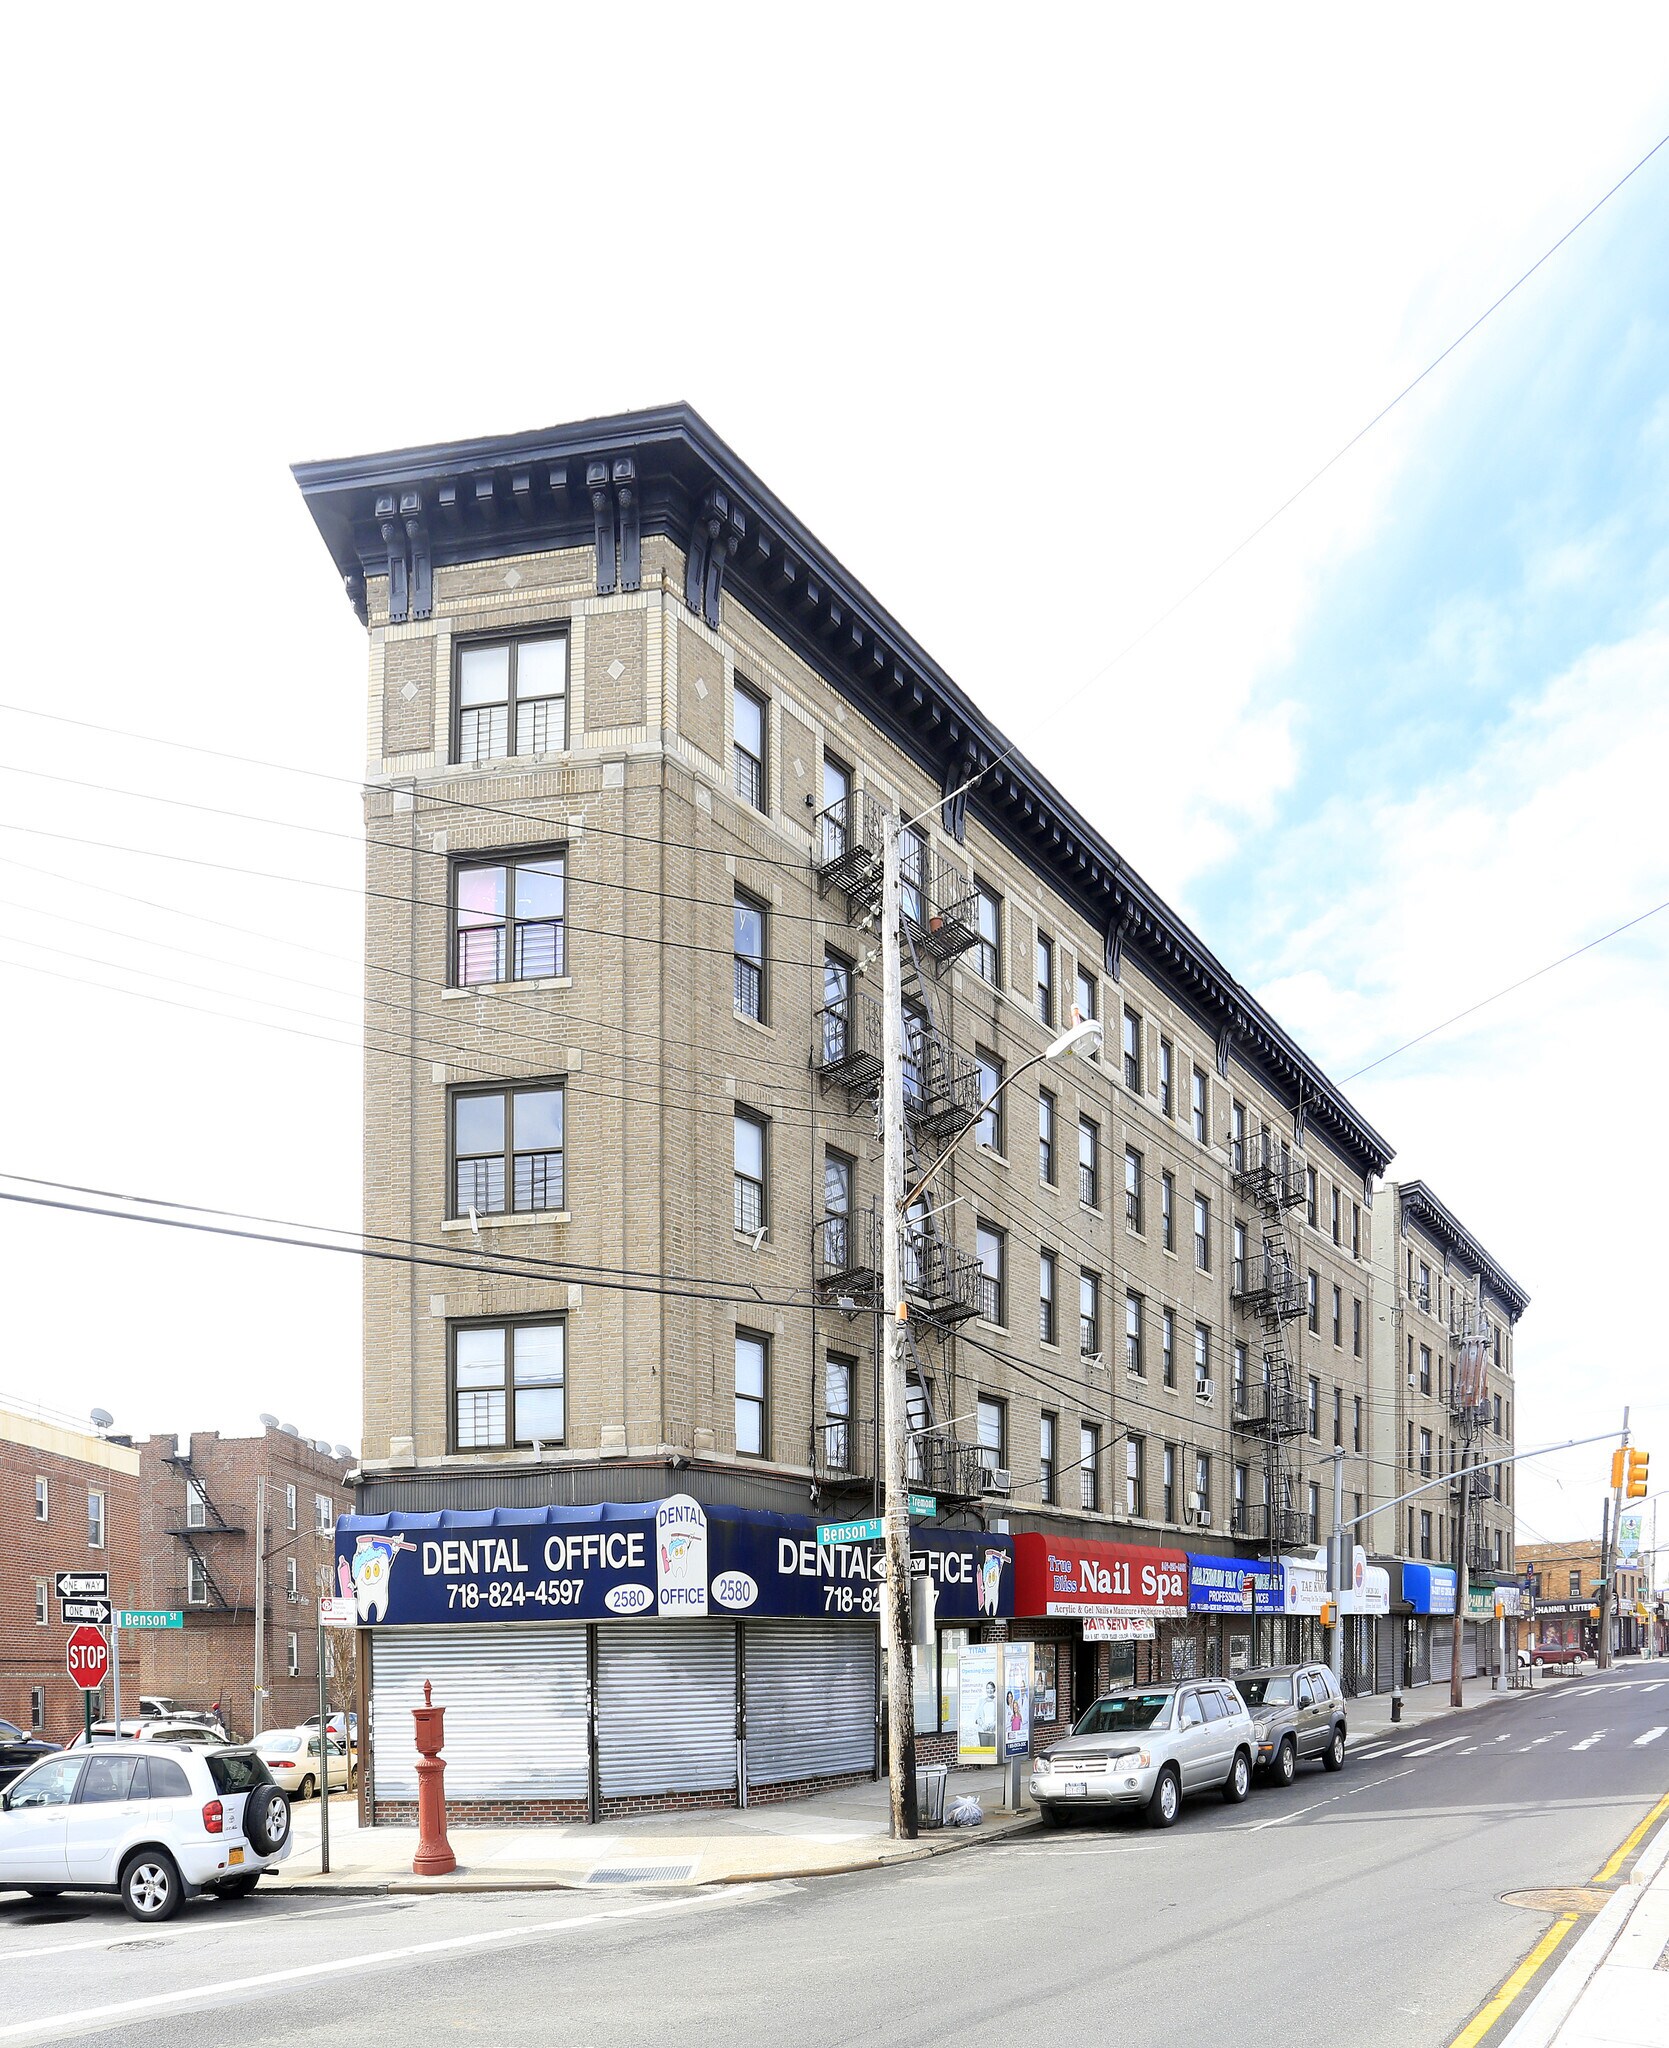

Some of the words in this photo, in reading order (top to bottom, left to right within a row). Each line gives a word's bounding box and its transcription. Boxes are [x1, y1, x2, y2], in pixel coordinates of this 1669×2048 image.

[912, 1496, 934, 1508] Tremont
[659, 1506, 705, 1529] DENTAL
[823, 1525, 866, 1542] Benson
[870, 1521, 877, 1530] St
[422, 1538, 529, 1576] DENTAL
[544, 1533, 646, 1572] OFFICE
[1048, 1555, 1072, 1573] True
[64, 1580, 78, 1590] ONE
[85, 1580, 101, 1590] WAY
[720, 1579, 750, 1602] 2580
[1054, 1575, 1077, 1592] Bliss
[1079, 1560, 1131, 1594] Nail
[1141, 1565, 1184, 1604] Spa
[1301, 1581, 1312, 1592] TAE
[446, 1579, 585, 1609] 718-824-4597
[613, 1583, 645, 1607] 2580
[660, 1588, 705, 1605] OFFICE
[1209, 1590, 1243, 1603] PROFESSIONA
[70, 1606, 83, 1616] ONE
[89, 1607, 104, 1617] WAY
[1054, 1605, 1077, 1615] Acrylic
[1078, 1606, 1082, 1614] &
[1084, 1606, 1094, 1614] Gel
[1095, 1606, 1109, 1614] Nails
[1112, 1606, 1137, 1615] Manicure
[1535, 1604, 1567, 1614] CHANNEL
[125, 1612, 167, 1626] Benson
[170, 1612, 177, 1621] St
[70, 1645, 106, 1669] STOP
